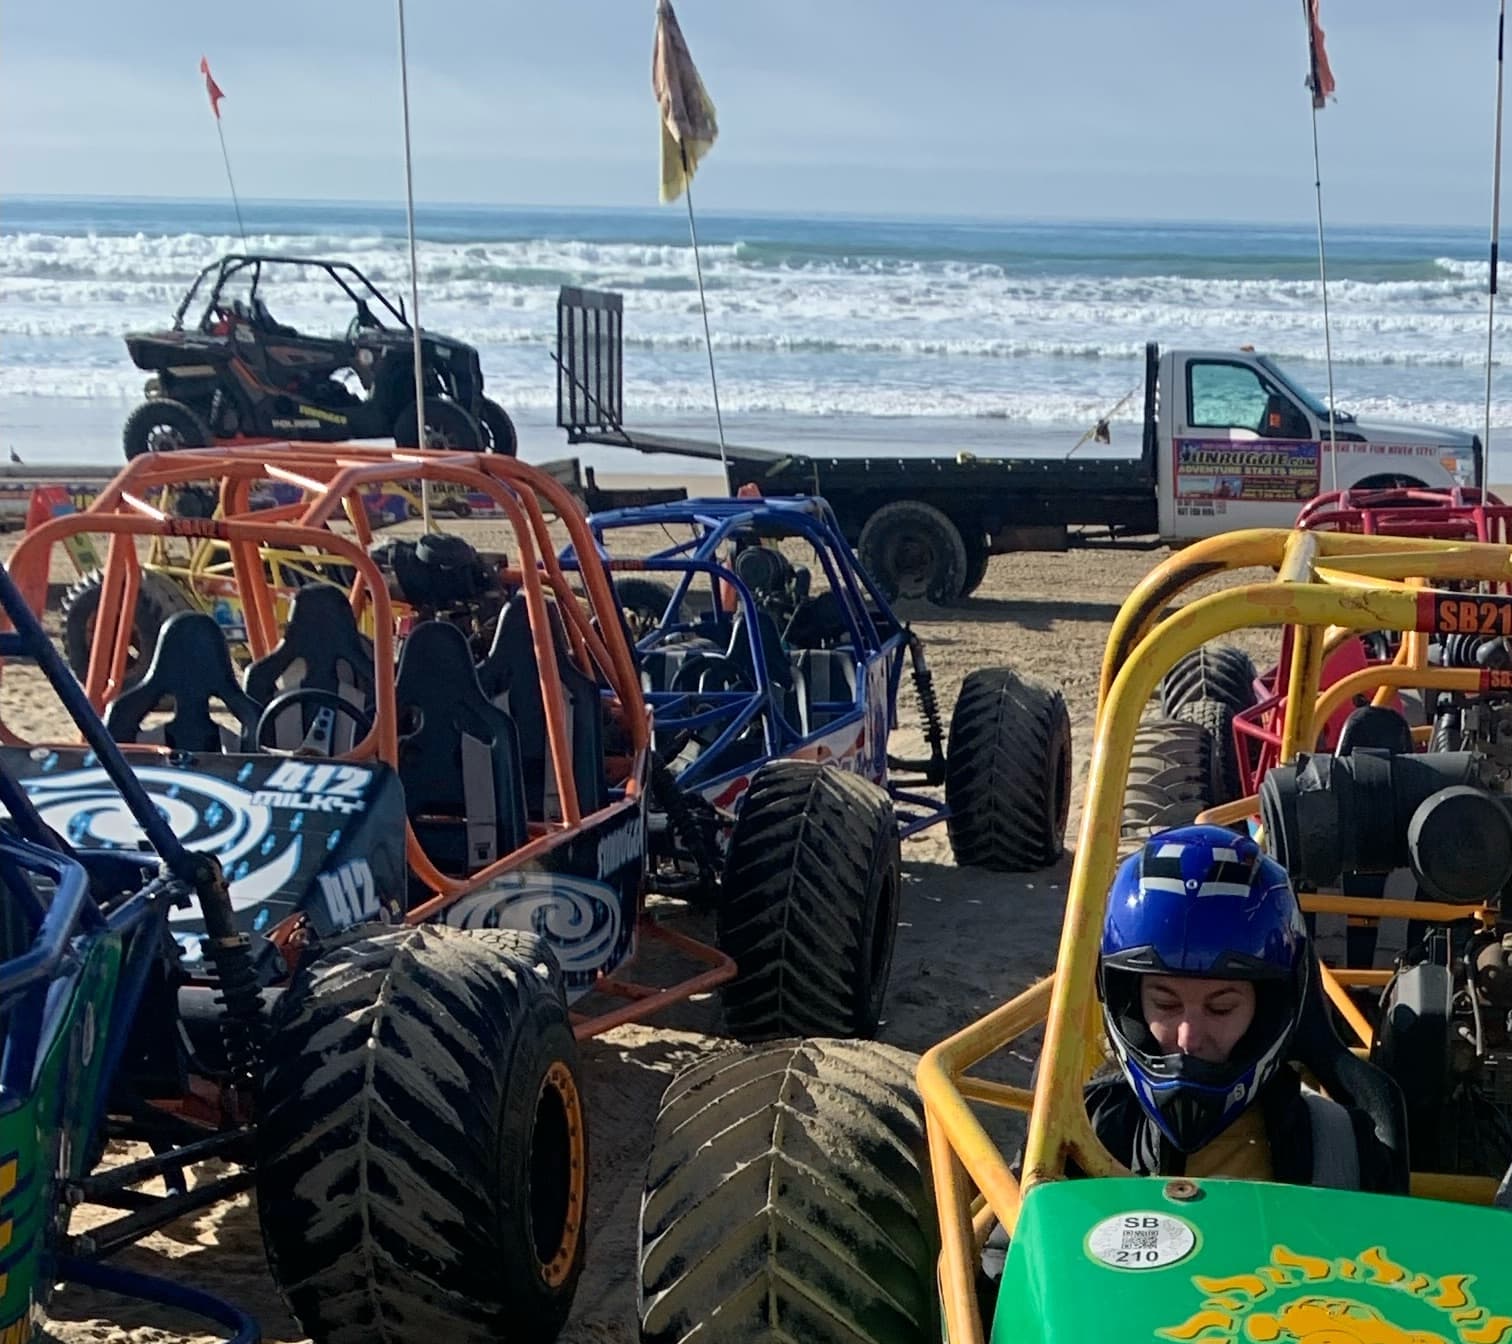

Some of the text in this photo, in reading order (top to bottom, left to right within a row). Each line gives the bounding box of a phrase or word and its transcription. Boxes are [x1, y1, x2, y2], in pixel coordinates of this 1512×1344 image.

[264, 759, 373, 797] 412
[251, 791, 366, 814] MILKY
[317, 858, 381, 928] 412
[1124, 1217, 1159, 1228] SB
[1116, 1251, 1159, 1262] 210
